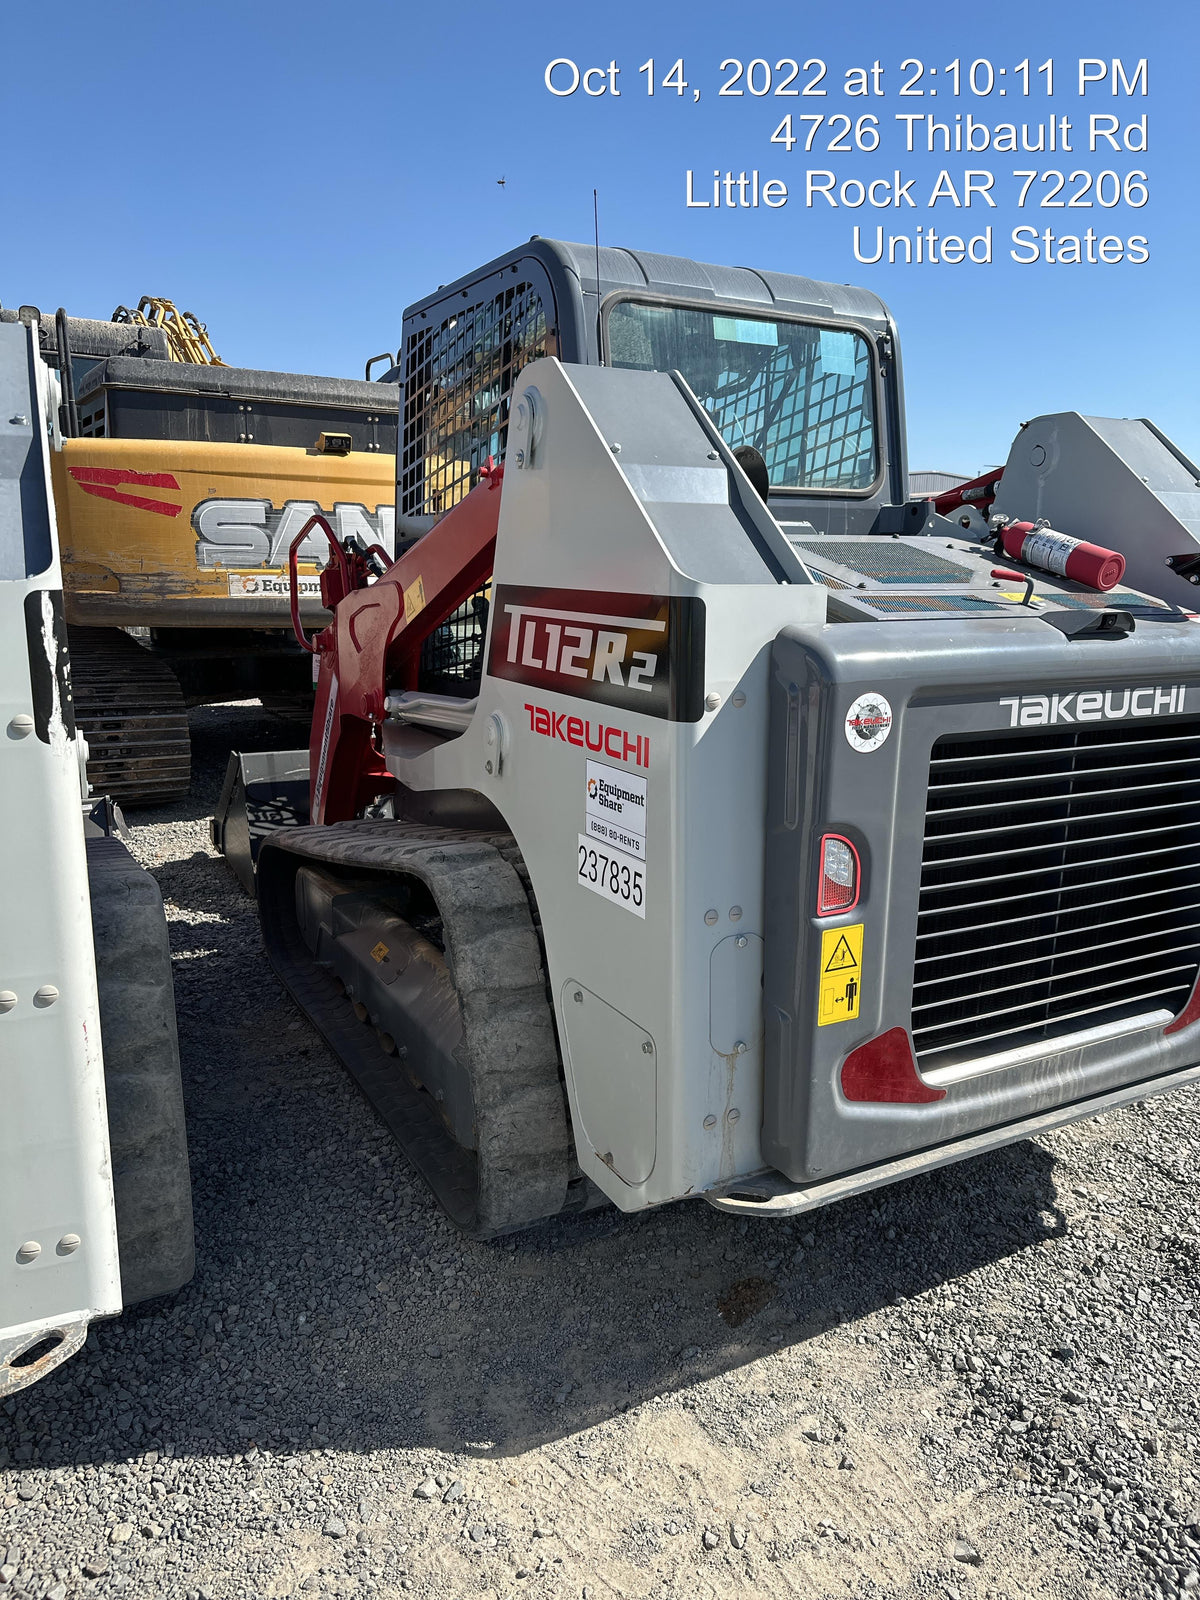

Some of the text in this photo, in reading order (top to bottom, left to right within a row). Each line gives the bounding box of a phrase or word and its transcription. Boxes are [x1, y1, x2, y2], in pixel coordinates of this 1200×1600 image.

[262, 579, 321, 595] Equpm
[503, 603, 667, 692] TL12R2
[1000, 685, 1186, 727] TAKEUCHI
[524, 703, 650, 768] TAKEUCHI
[598, 793, 623, 814] Share
[599, 778, 645, 807] Equipment
[590, 820, 640, 851] (888) 80-RENTS
[578, 845, 643, 907] 237835
